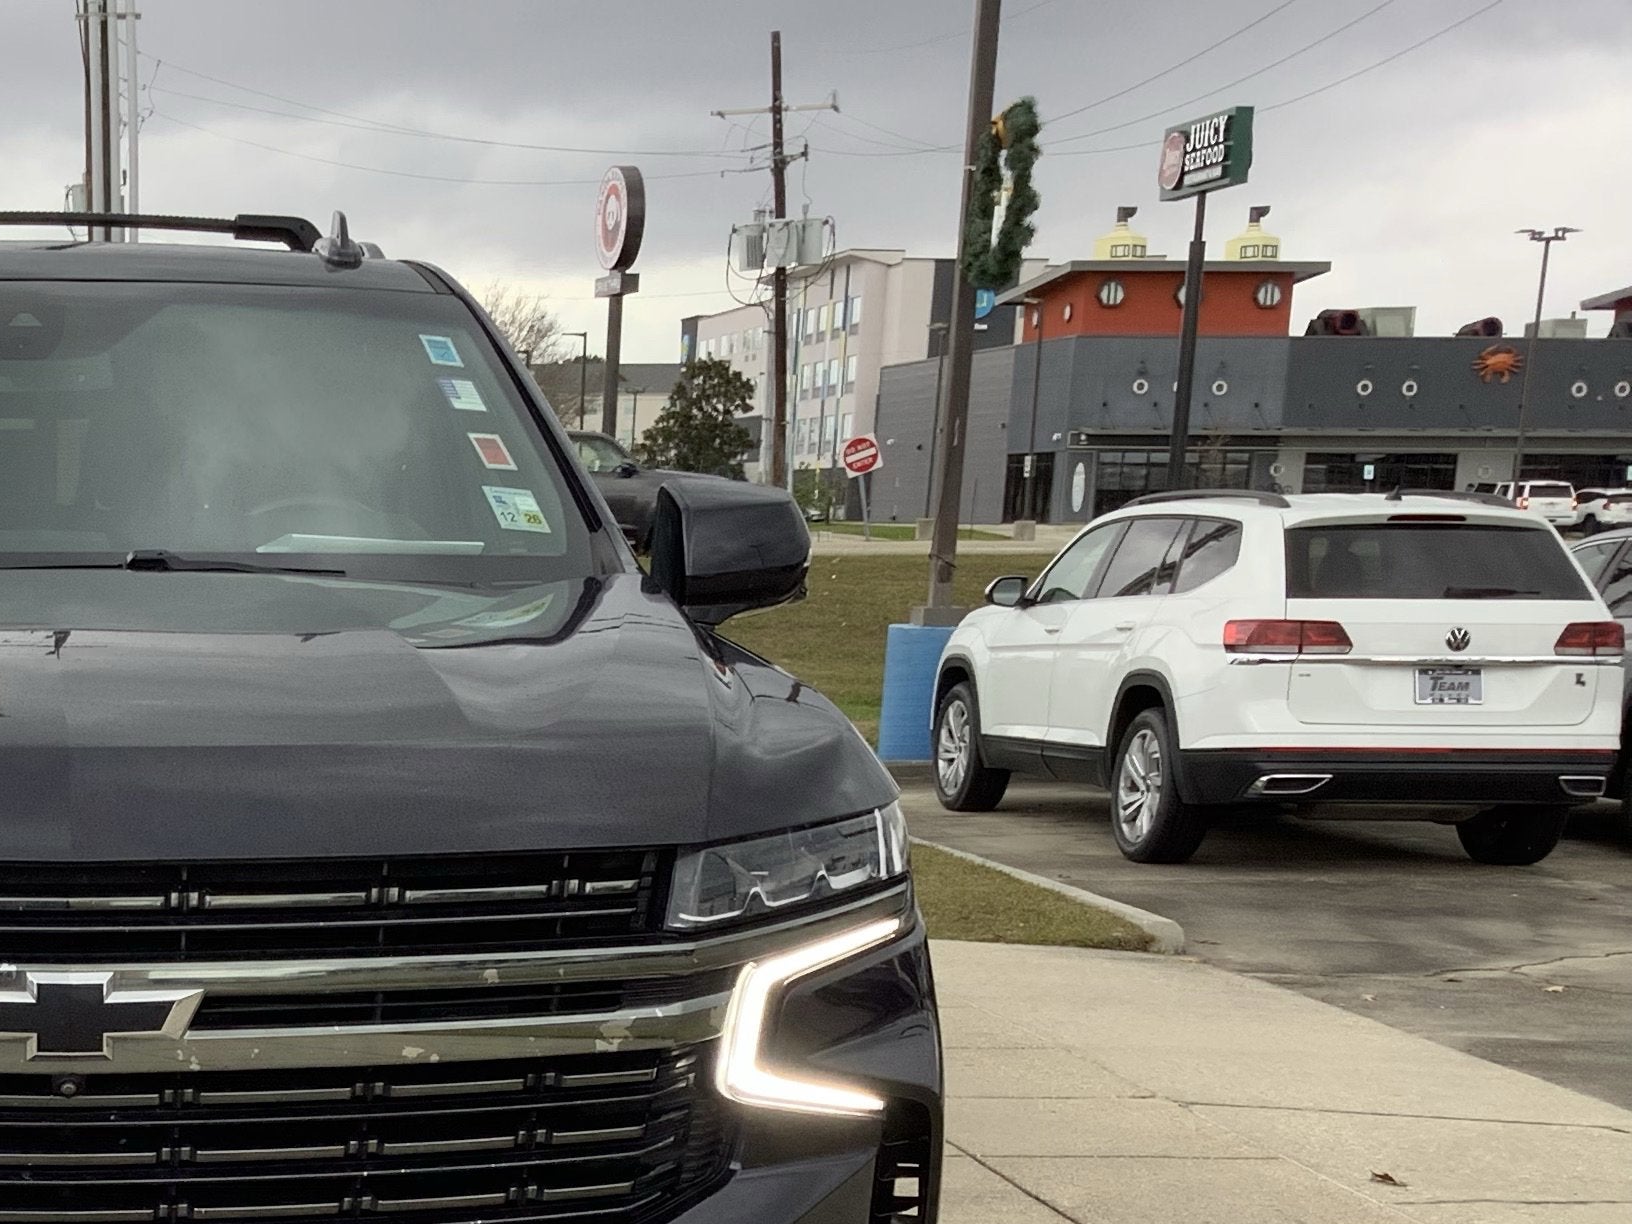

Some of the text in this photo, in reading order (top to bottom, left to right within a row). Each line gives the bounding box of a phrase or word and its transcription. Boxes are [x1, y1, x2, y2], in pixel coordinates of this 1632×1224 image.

[1185, 115, 1228, 152] JUICY
[1184, 144, 1225, 172] SEAFOOD
[500, 511, 517, 523] 12
